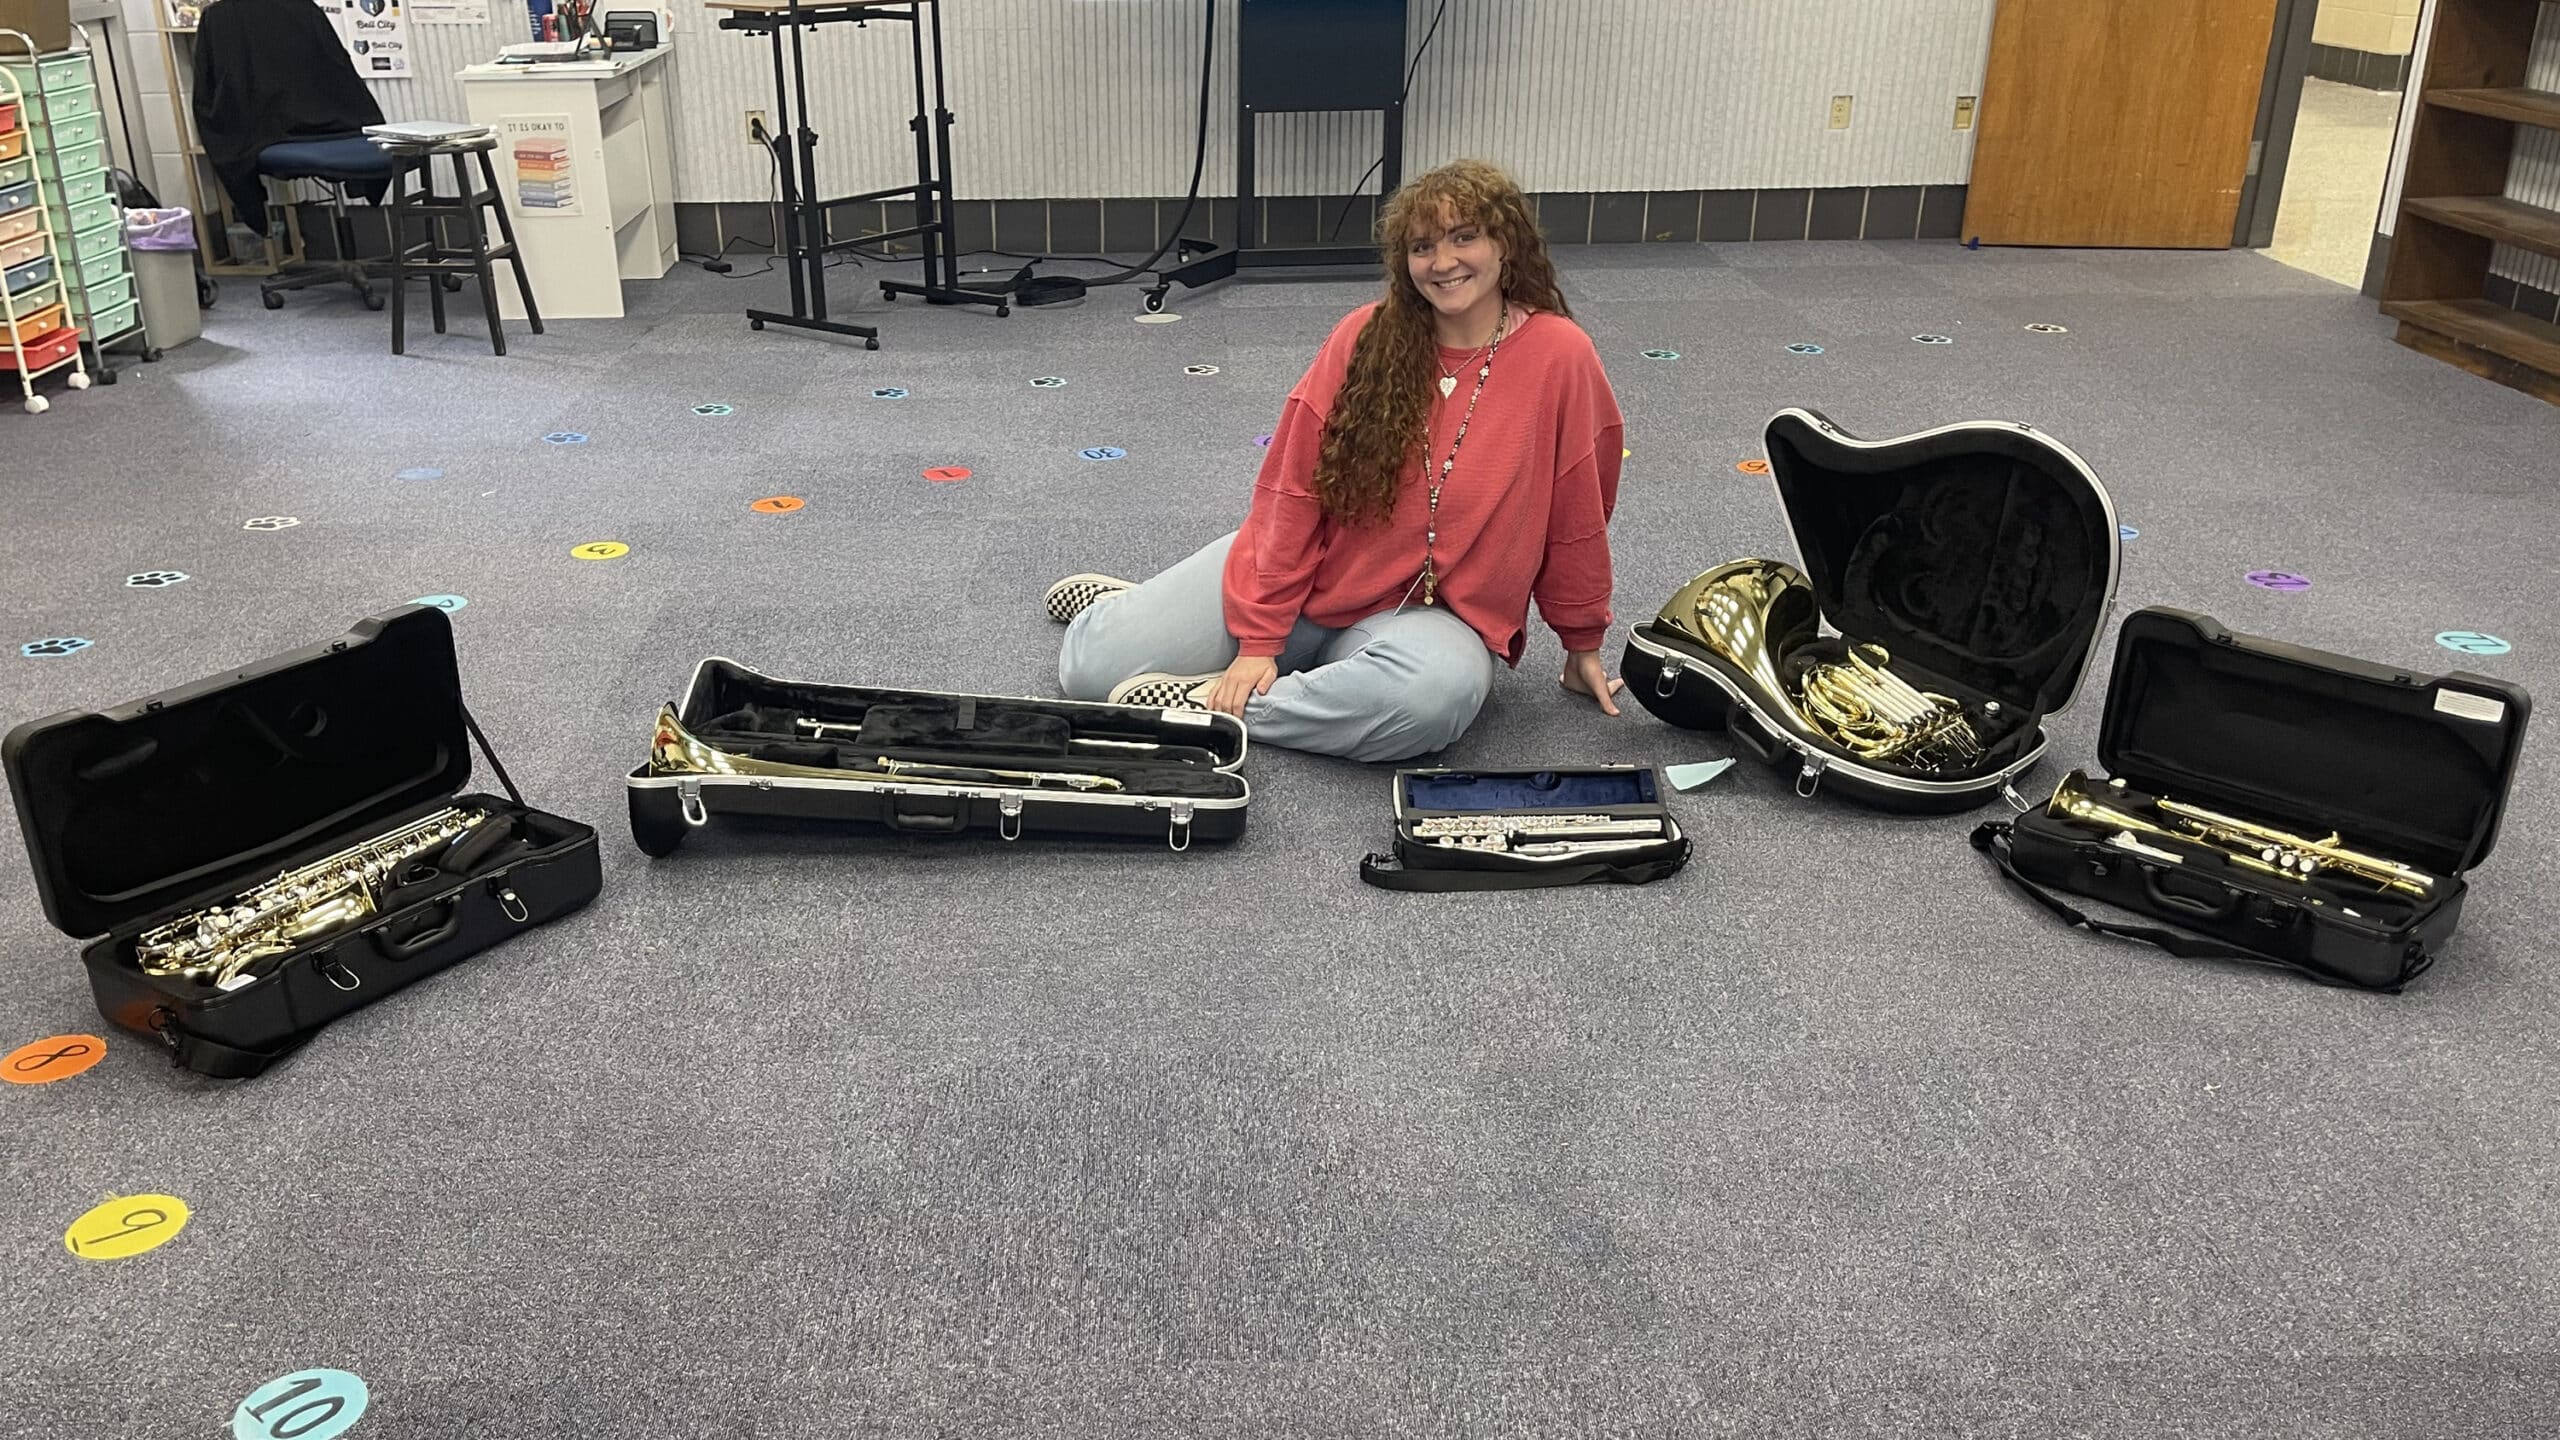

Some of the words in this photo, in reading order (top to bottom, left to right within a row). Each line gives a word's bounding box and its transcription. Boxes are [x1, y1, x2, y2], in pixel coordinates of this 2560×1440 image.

[377, 20, 396, 31] City
[507, 124, 517, 132] IT
[520, 123, 529, 132] IS
[531, 123, 552, 132] OKAY
[555, 122, 565, 131] TO
[14, 1043, 90, 1072] 8
[244, 1377, 345, 1440] 10
